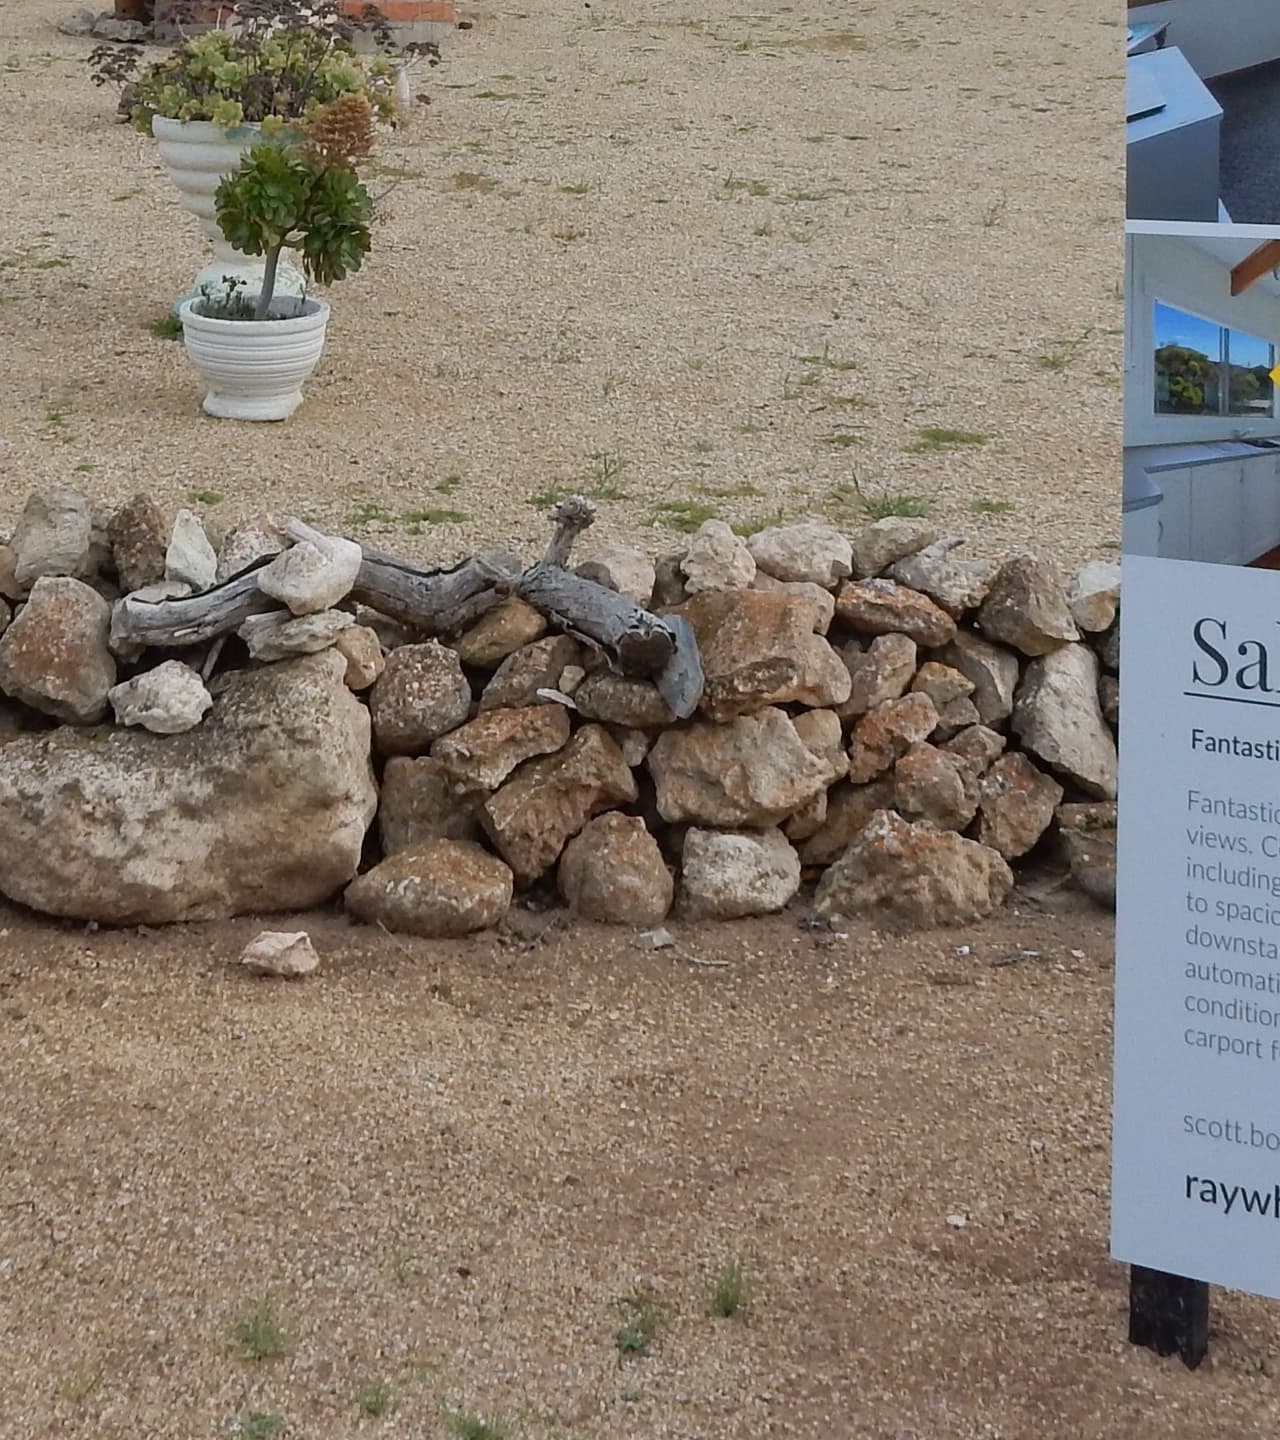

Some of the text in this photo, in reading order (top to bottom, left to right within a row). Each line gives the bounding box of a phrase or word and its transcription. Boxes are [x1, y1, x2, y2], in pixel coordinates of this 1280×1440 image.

[1187, 825, 1253, 854] views.
[1187, 892, 1208, 913] to
[1185, 1029, 1262, 1058] carport
